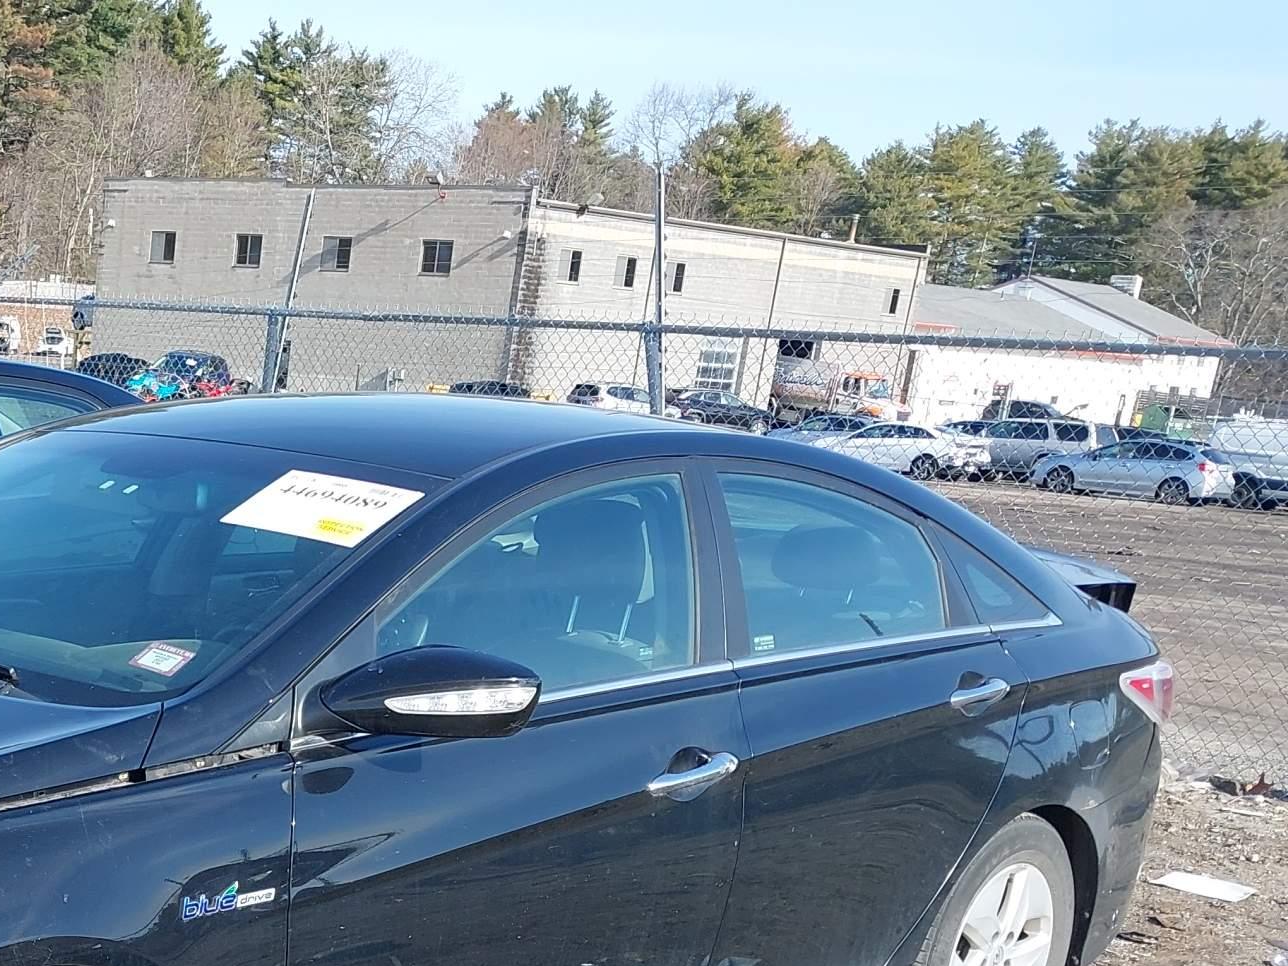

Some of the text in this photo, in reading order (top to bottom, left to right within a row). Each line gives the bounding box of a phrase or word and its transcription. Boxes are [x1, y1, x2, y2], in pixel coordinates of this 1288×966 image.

[280, 484, 388, 509] 44694089
[182, 890, 273, 920] blue drive
